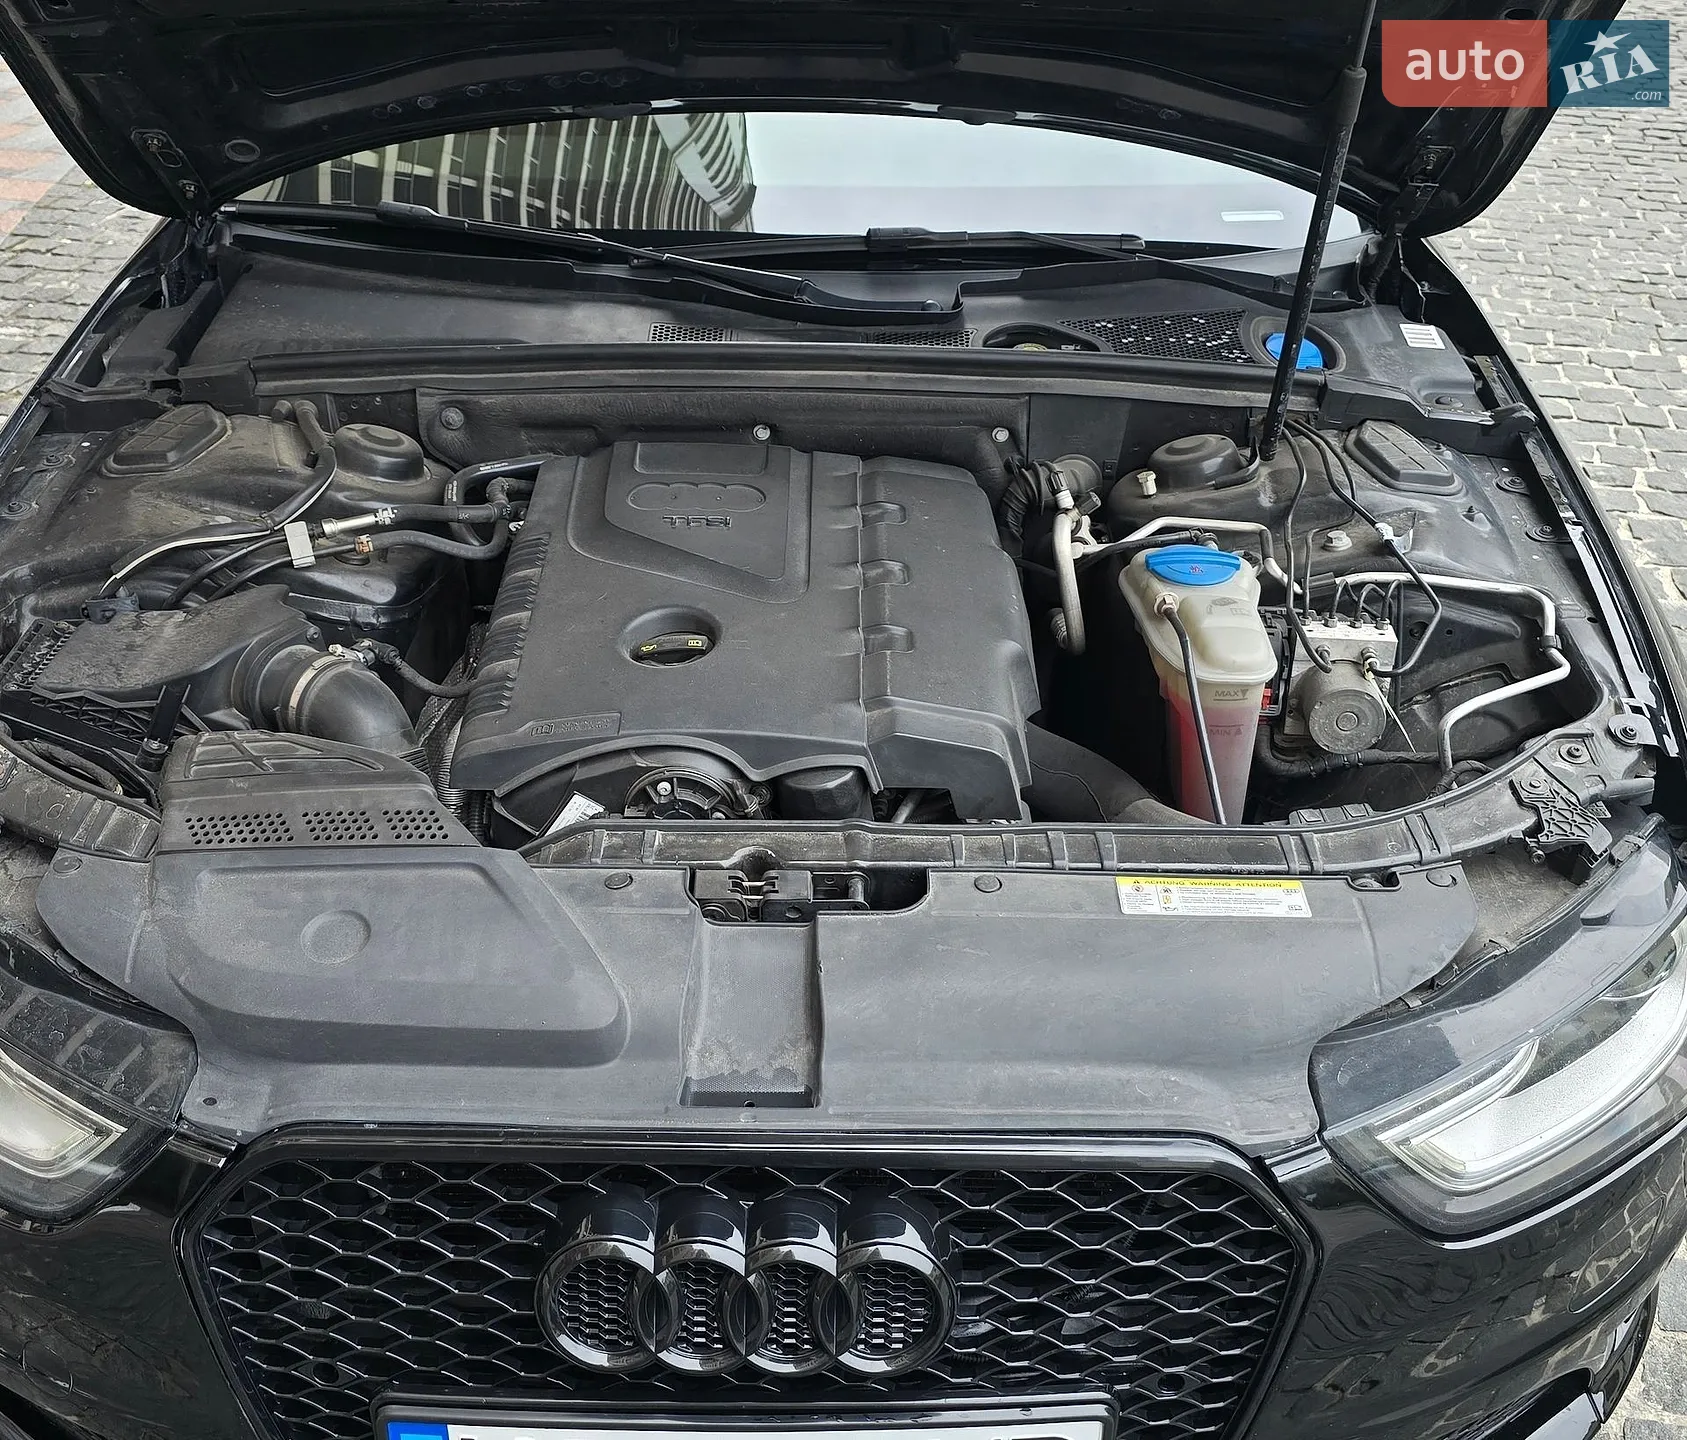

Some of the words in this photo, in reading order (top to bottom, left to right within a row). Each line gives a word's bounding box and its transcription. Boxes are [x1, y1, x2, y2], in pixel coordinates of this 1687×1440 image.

[662, 514, 732, 529] TFSI
[1214, 689, 1239, 698] MAX
[1209, 728, 1231, 736] MIN
